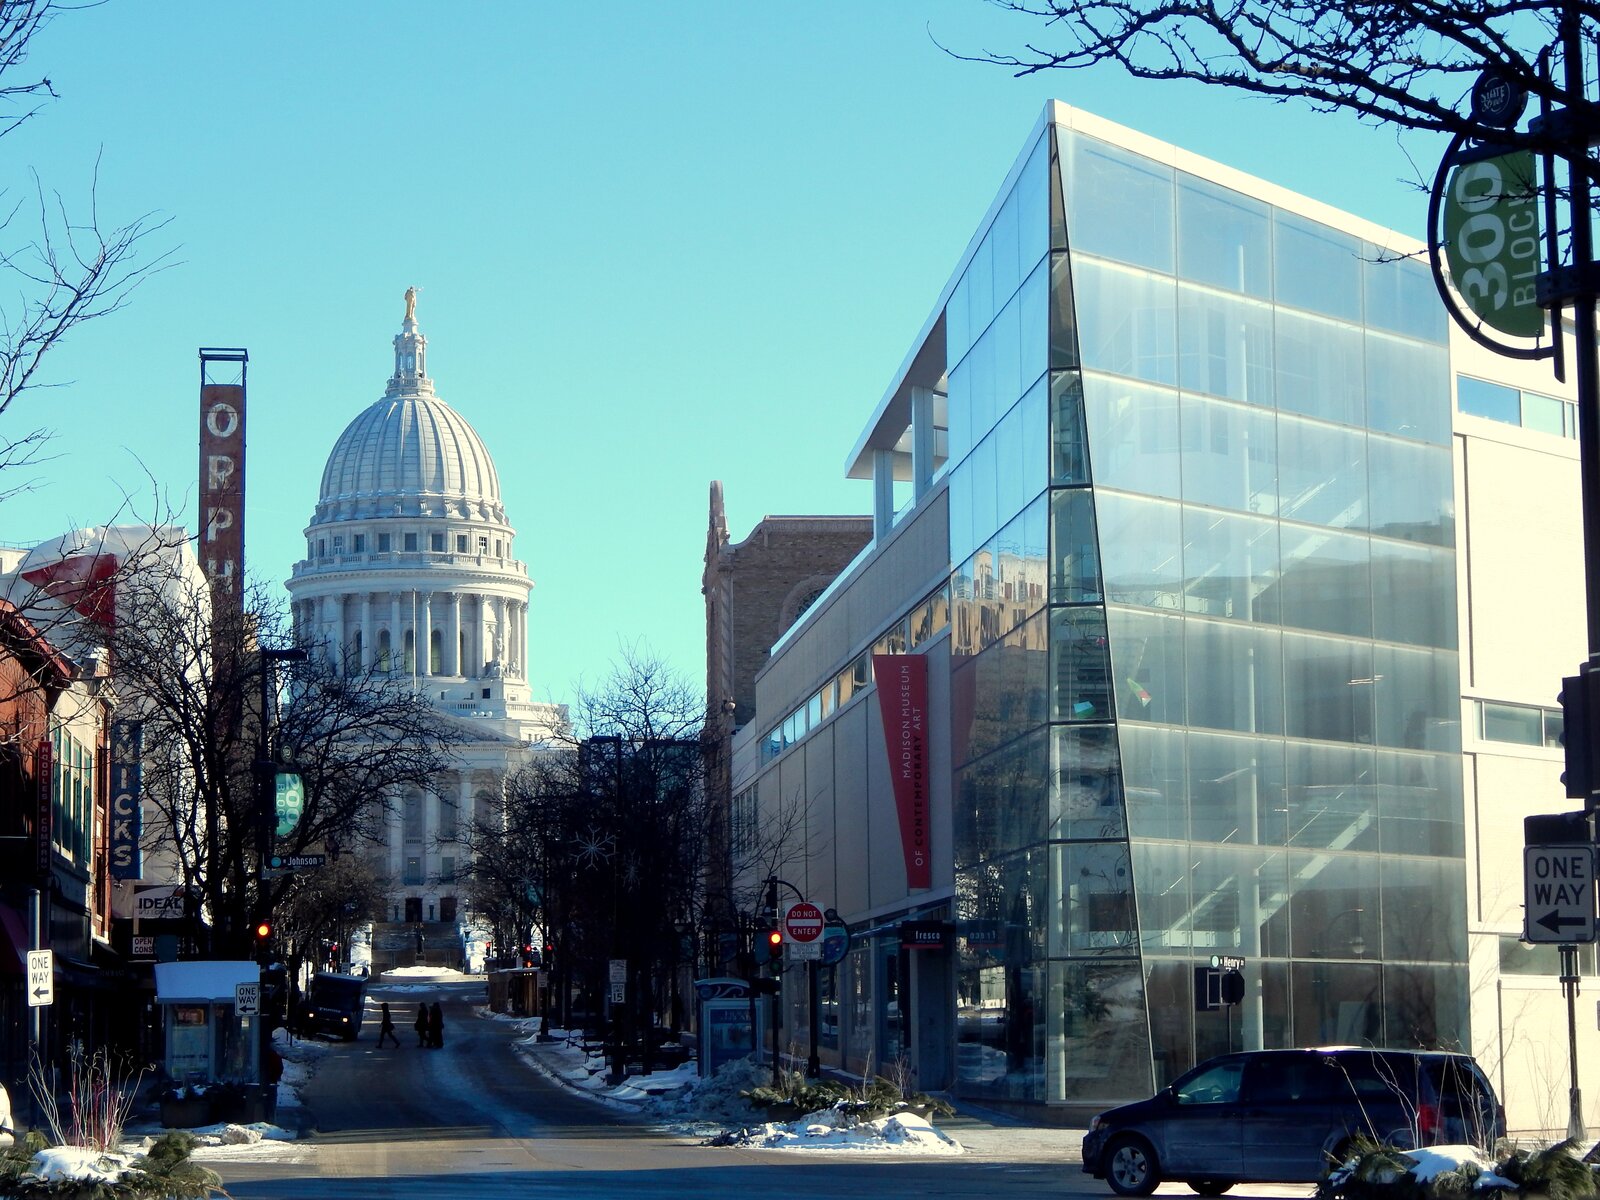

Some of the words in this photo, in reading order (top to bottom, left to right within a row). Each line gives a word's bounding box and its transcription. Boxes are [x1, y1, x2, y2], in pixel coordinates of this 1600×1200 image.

[1455, 162, 1508, 311] 300
[1508, 189, 1538, 308] BLOCK
[901, 664, 910, 717] MUSEUM
[912, 707, 921, 730] ART
[902, 720, 911, 778] MADISON
[41, 745, 49, 800] NOODLES
[285, 773, 300, 826] 200
[913, 735, 923, 847] CONTEMPORARY
[288, 856, 318, 866] Johnson
[915, 849, 924, 866] OF
[1535, 856, 1585, 878] ONE
[138, 897, 182, 909] IDEAL
[1534, 884, 1585, 905] WAY
[791, 910, 801, 918] DO
[803, 910, 817, 918] NOT
[915, 930, 941, 940] fresco
[31, 956, 49, 970] ONE
[1223, 956, 1240, 970] Henry
[31, 971, 49, 984] WAY
[238, 987, 256, 996] ONE
[238, 996, 256, 1004] WAY
[613, 993, 623, 1001] 15
